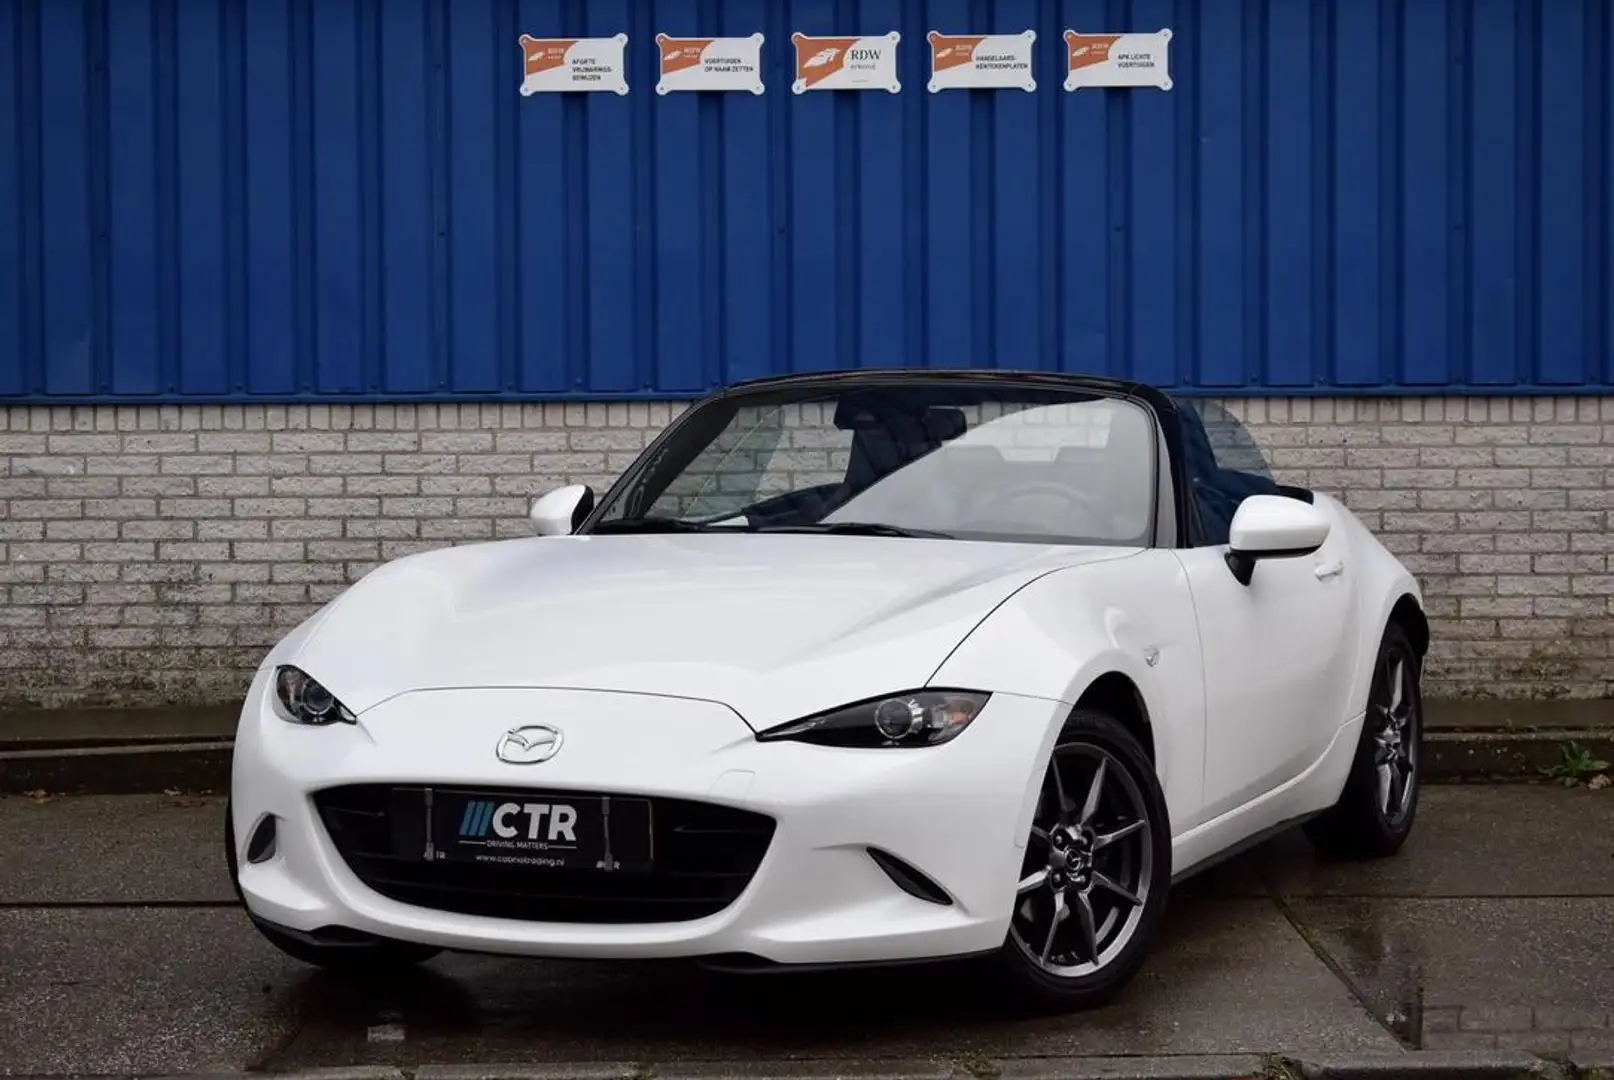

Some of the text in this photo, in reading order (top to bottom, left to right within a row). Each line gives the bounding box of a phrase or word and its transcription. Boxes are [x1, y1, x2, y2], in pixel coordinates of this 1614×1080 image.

[851, 49, 881, 60] RDW
[492, 802, 577, 841] CTR
[486, 840, 548, 850] DRIVING MATTERS
